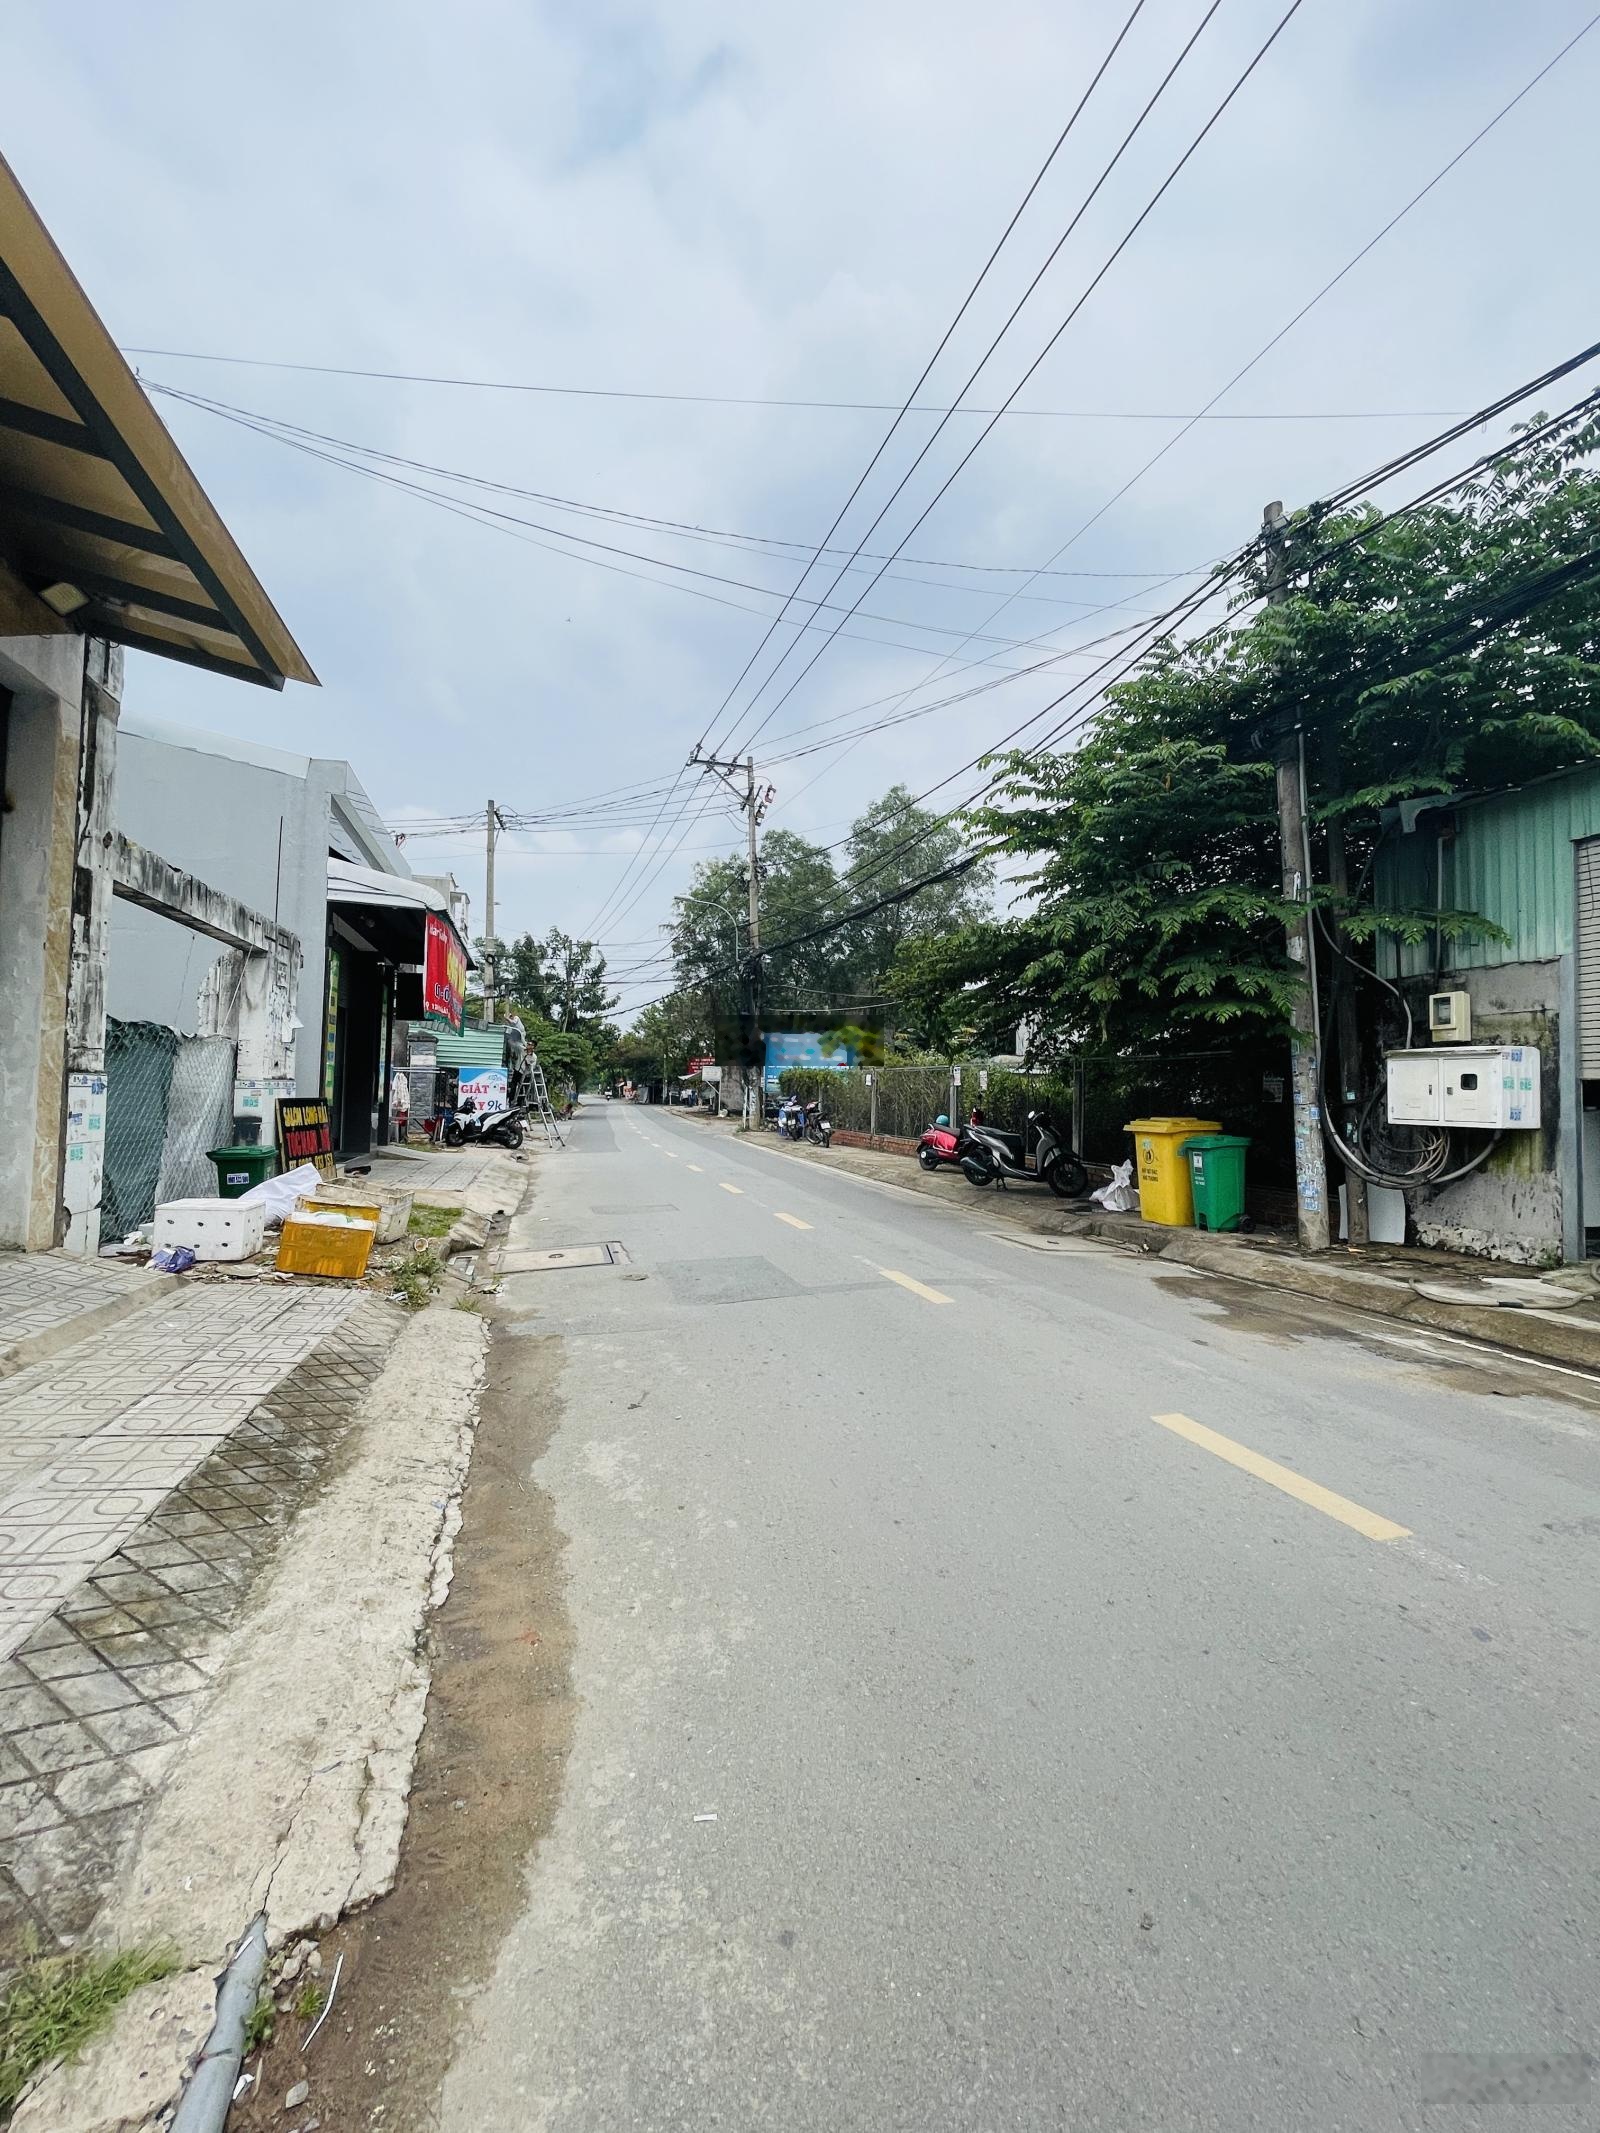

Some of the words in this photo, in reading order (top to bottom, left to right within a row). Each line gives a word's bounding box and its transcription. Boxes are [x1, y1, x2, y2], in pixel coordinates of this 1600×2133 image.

[488, 1100, 502, 1111] 9k
[283, 1107, 303, 1127] SALON
[302, 1106, 318, 1126] LONG
